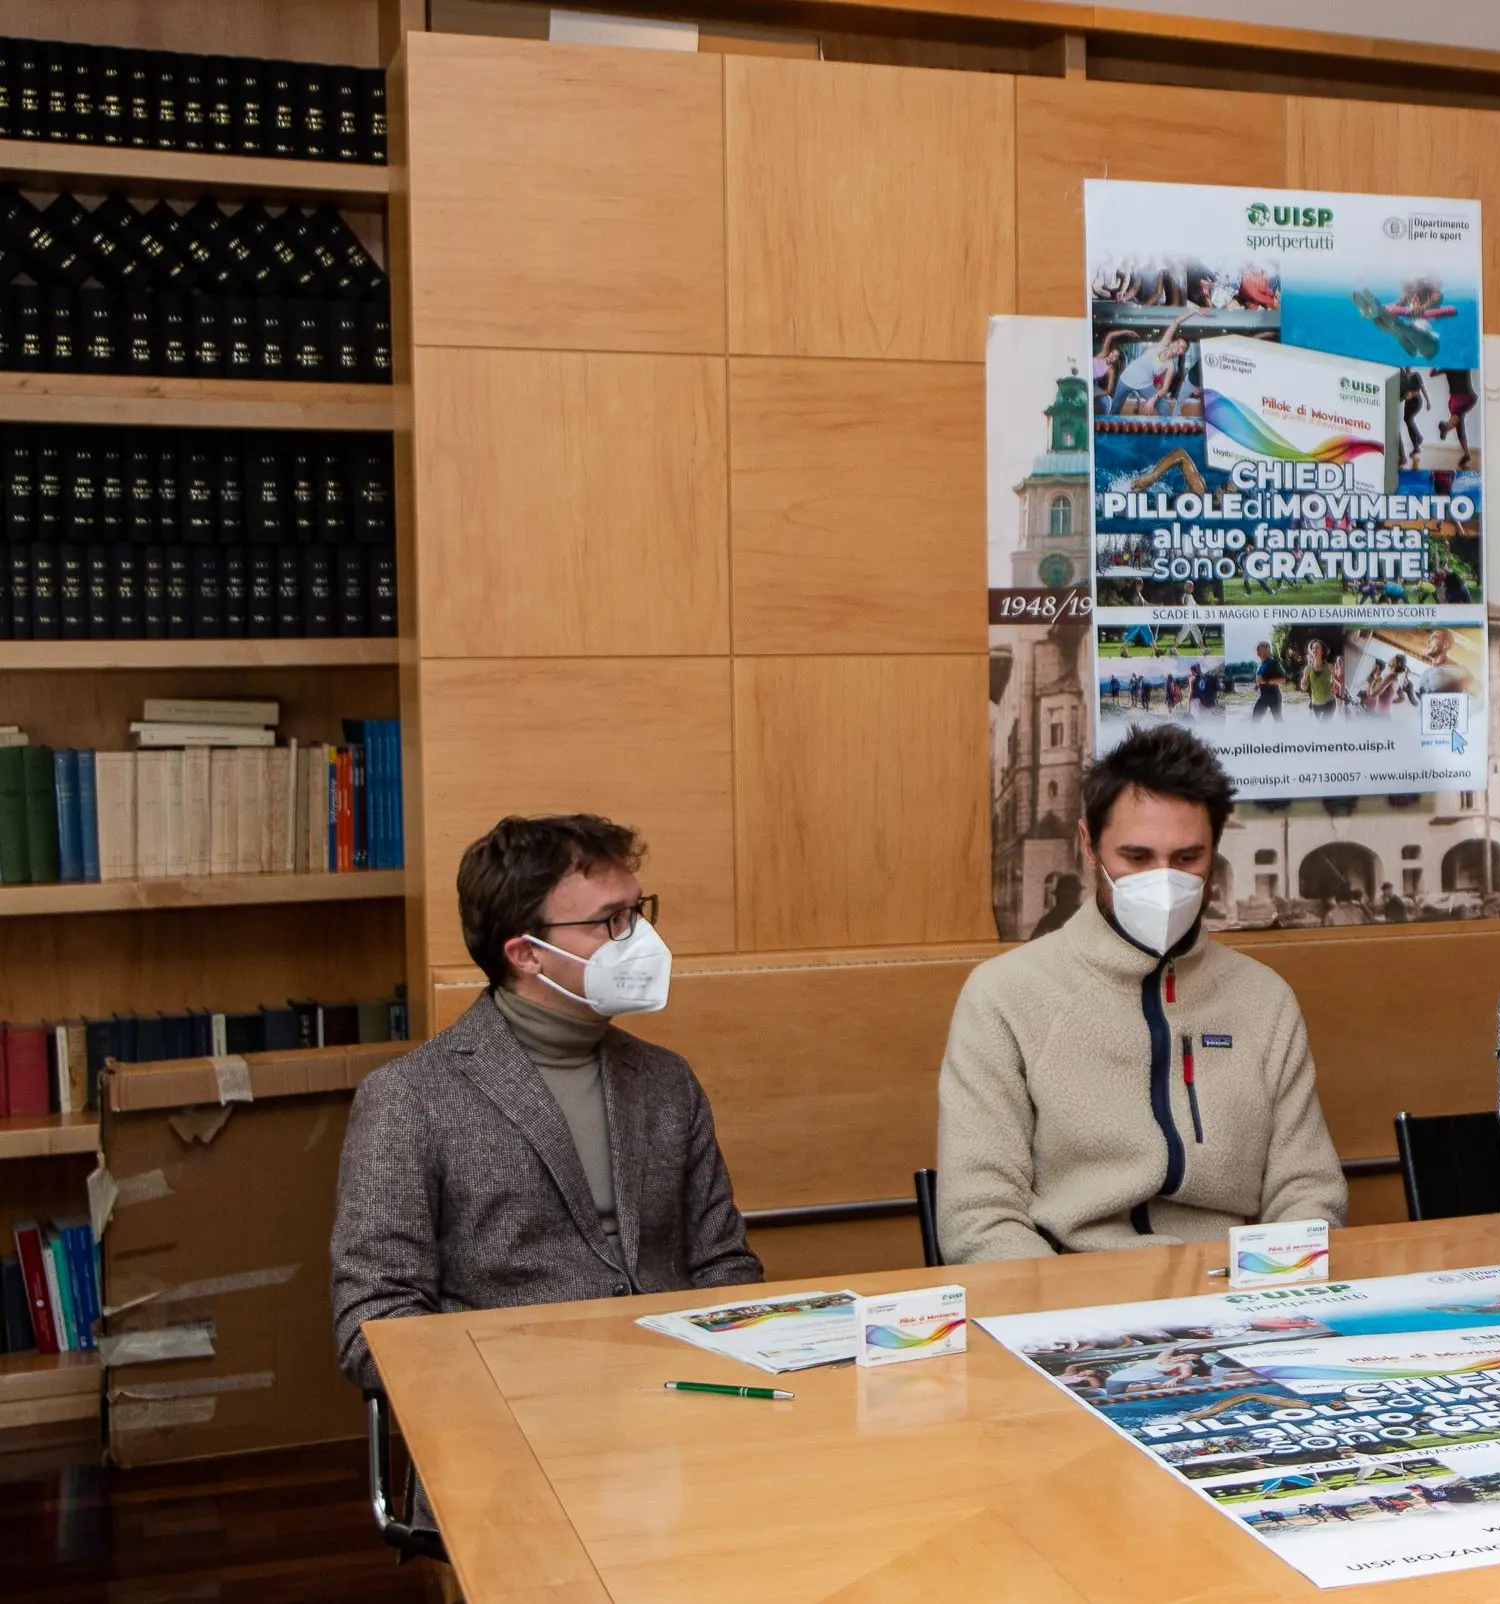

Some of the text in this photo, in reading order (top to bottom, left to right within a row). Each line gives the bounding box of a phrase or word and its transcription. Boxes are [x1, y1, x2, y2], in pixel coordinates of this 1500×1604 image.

[1273, 205, 1334, 229] UISP
[1413, 217, 1470, 231] Dipartimento
[1246, 233, 1335, 252] sportpertutti
[1413, 230, 1463, 242] per lo sport
[1351, 381, 1381, 395] UISP
[1261, 396, 1372, 431] Pillole di Movimento
[1231, 460, 1355, 492] CHIEDI
[1152, 521, 1181, 550] al
[1189, 527, 1246, 551] tuo
[1152, 550, 1430, 581] sono GRATUITE!
[1151, 607, 1438, 620] SCADE IL 31 MAGGIO E FINO AD ESAURIMENTO SCORTE
[1209, 739, 1396, 757] ww.pilloledimovimento.uisp.it
[1298, 771, 1362, 785] 0471300057
[1369, 768, 1472, 784] www.uisp.it/bolzano
[1265, 1283, 1352, 1298] UISP
[1252, 1419, 1300, 1440] al
[1267, 1426, 1418, 1455] sono
[1345, 1558, 1397, 1572] UISP
